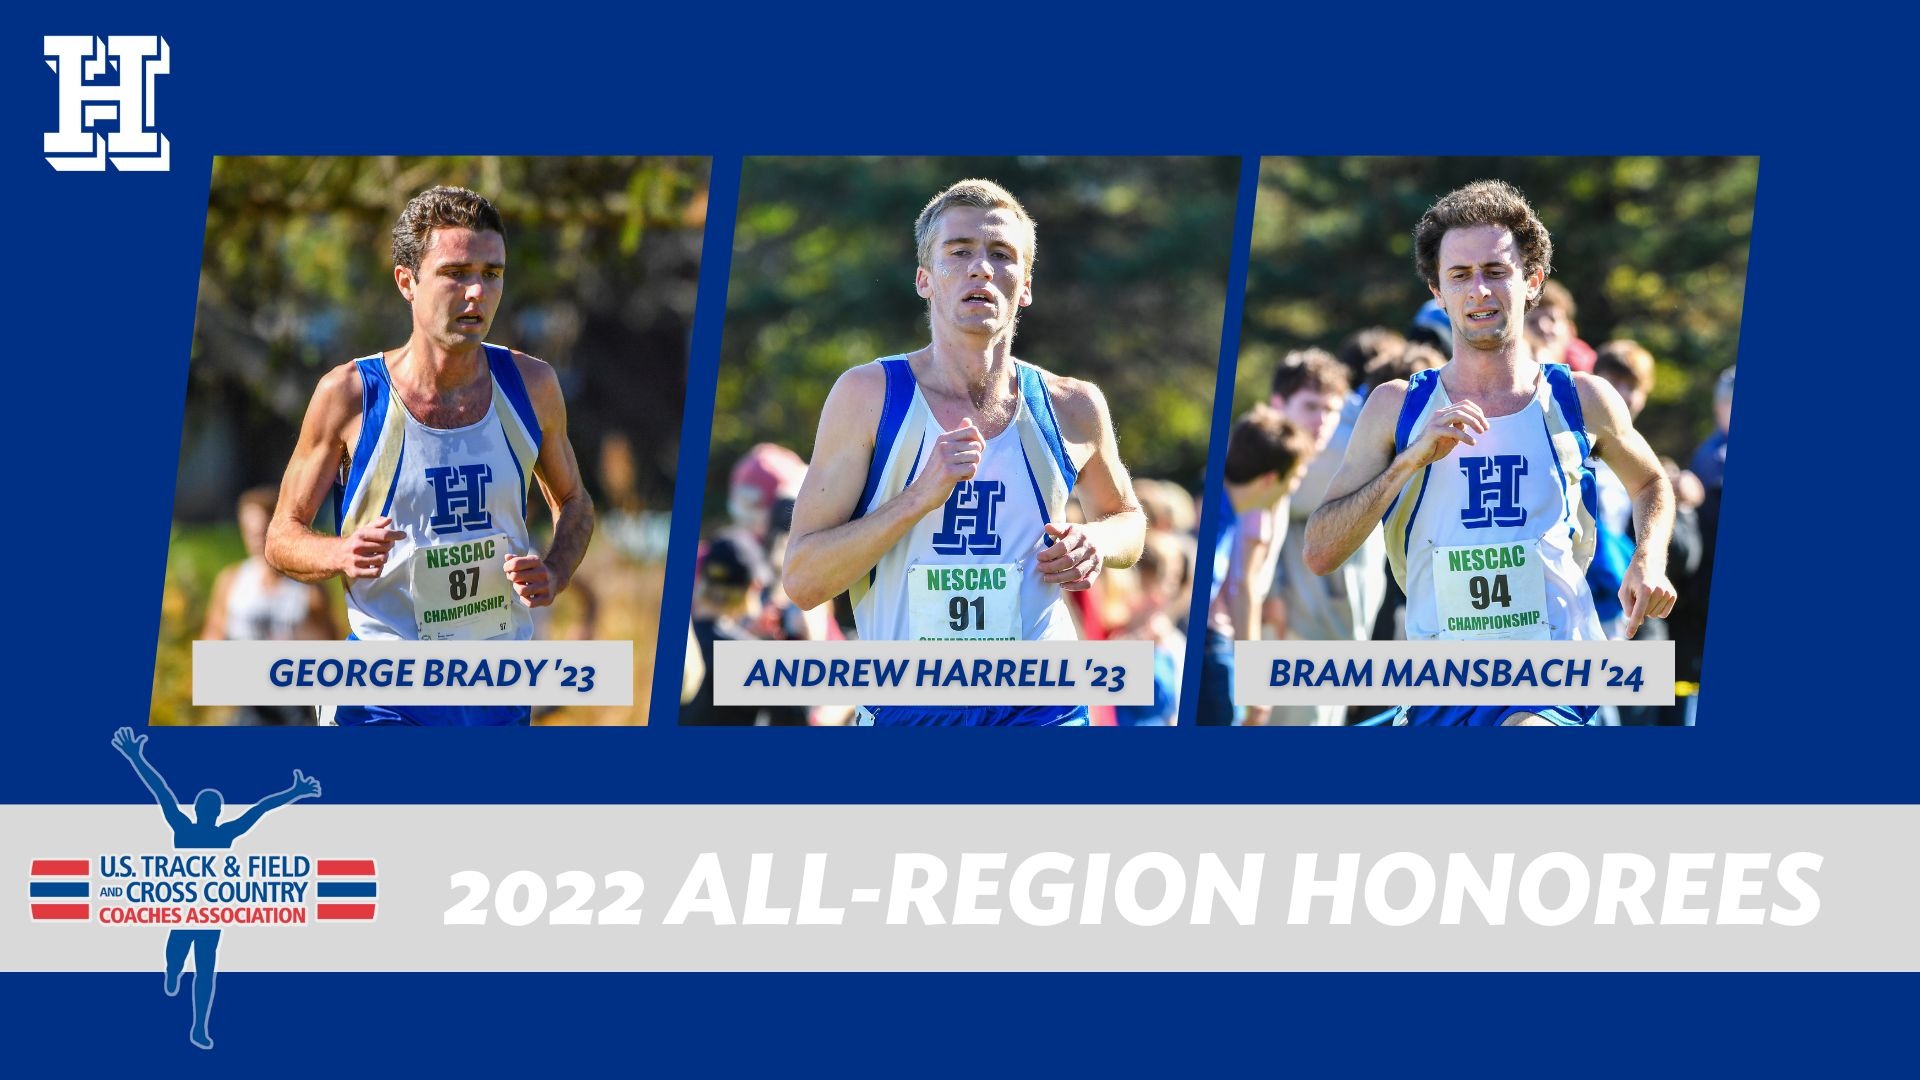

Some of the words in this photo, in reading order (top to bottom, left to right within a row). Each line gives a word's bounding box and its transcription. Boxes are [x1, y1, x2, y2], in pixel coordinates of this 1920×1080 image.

[425, 463, 493, 535] H
[1459, 454, 1528, 529] H
[932, 480, 1006, 556] H
[426, 539, 496, 569] NESCAC
[1448, 544, 1526, 572] NESCAC
[448, 566, 480, 601] 87
[926, 567, 1007, 591] NESCAC
[1469, 574, 1512, 610] 94
[423, 595, 505, 624] CHAMPIONSHIP
[948, 596, 985, 631] 91
[1447, 610, 1540, 631] CHAMPIONSHIP
